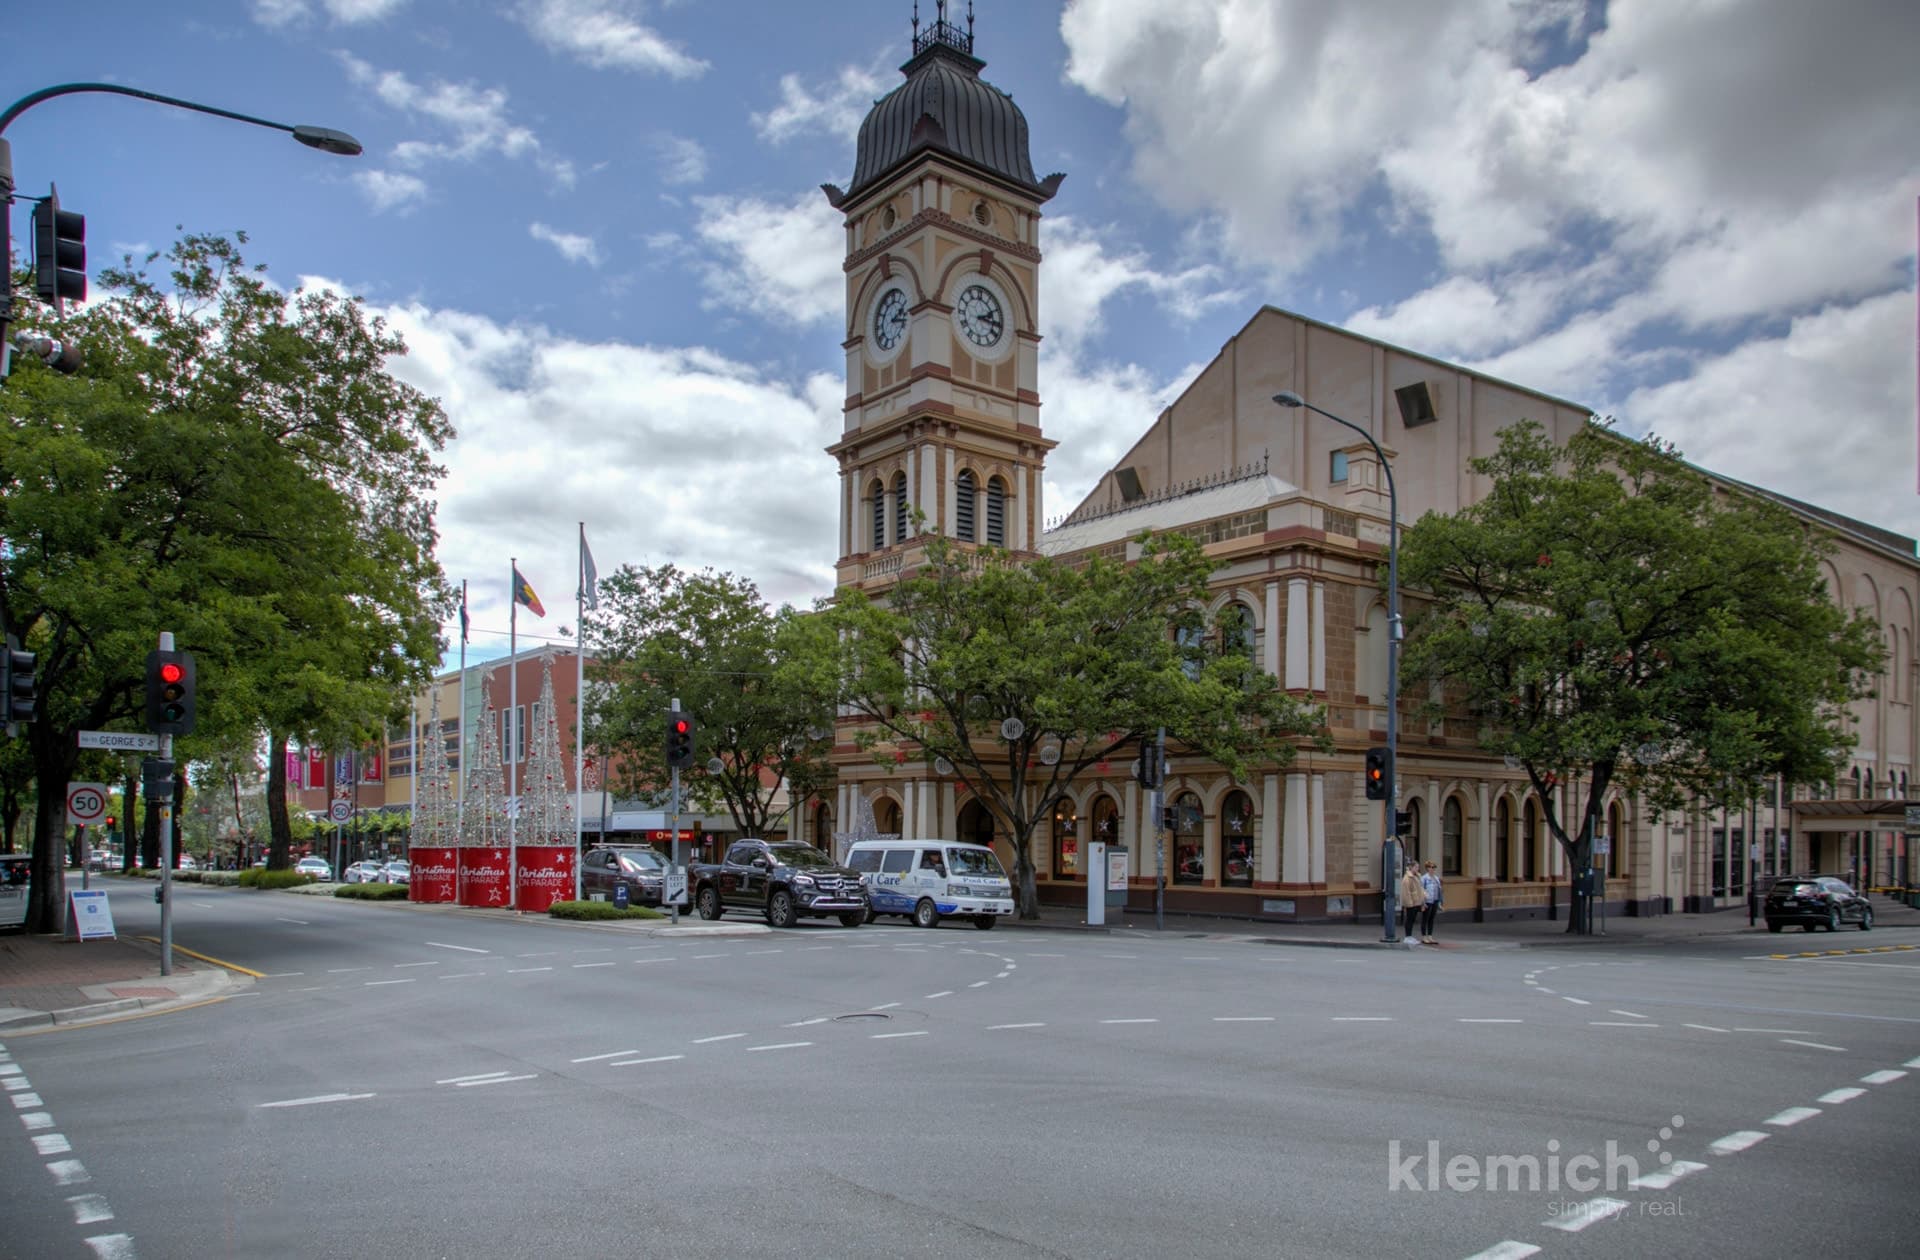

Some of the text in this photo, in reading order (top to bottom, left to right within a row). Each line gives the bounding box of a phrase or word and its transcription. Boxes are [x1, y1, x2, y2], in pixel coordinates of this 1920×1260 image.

[99, 735, 135, 747] GEORGE
[75, 796, 98, 811] 50
[335, 807, 346, 815] 50
[413, 864, 456, 874] Christmas
[460, 865, 505, 876] Christmas
[519, 865, 568, 878] Christmas
[519, 878, 563, 887] ON PARADE
[877, 873, 902, 886] Care
[617, 886, 626, 896] P
